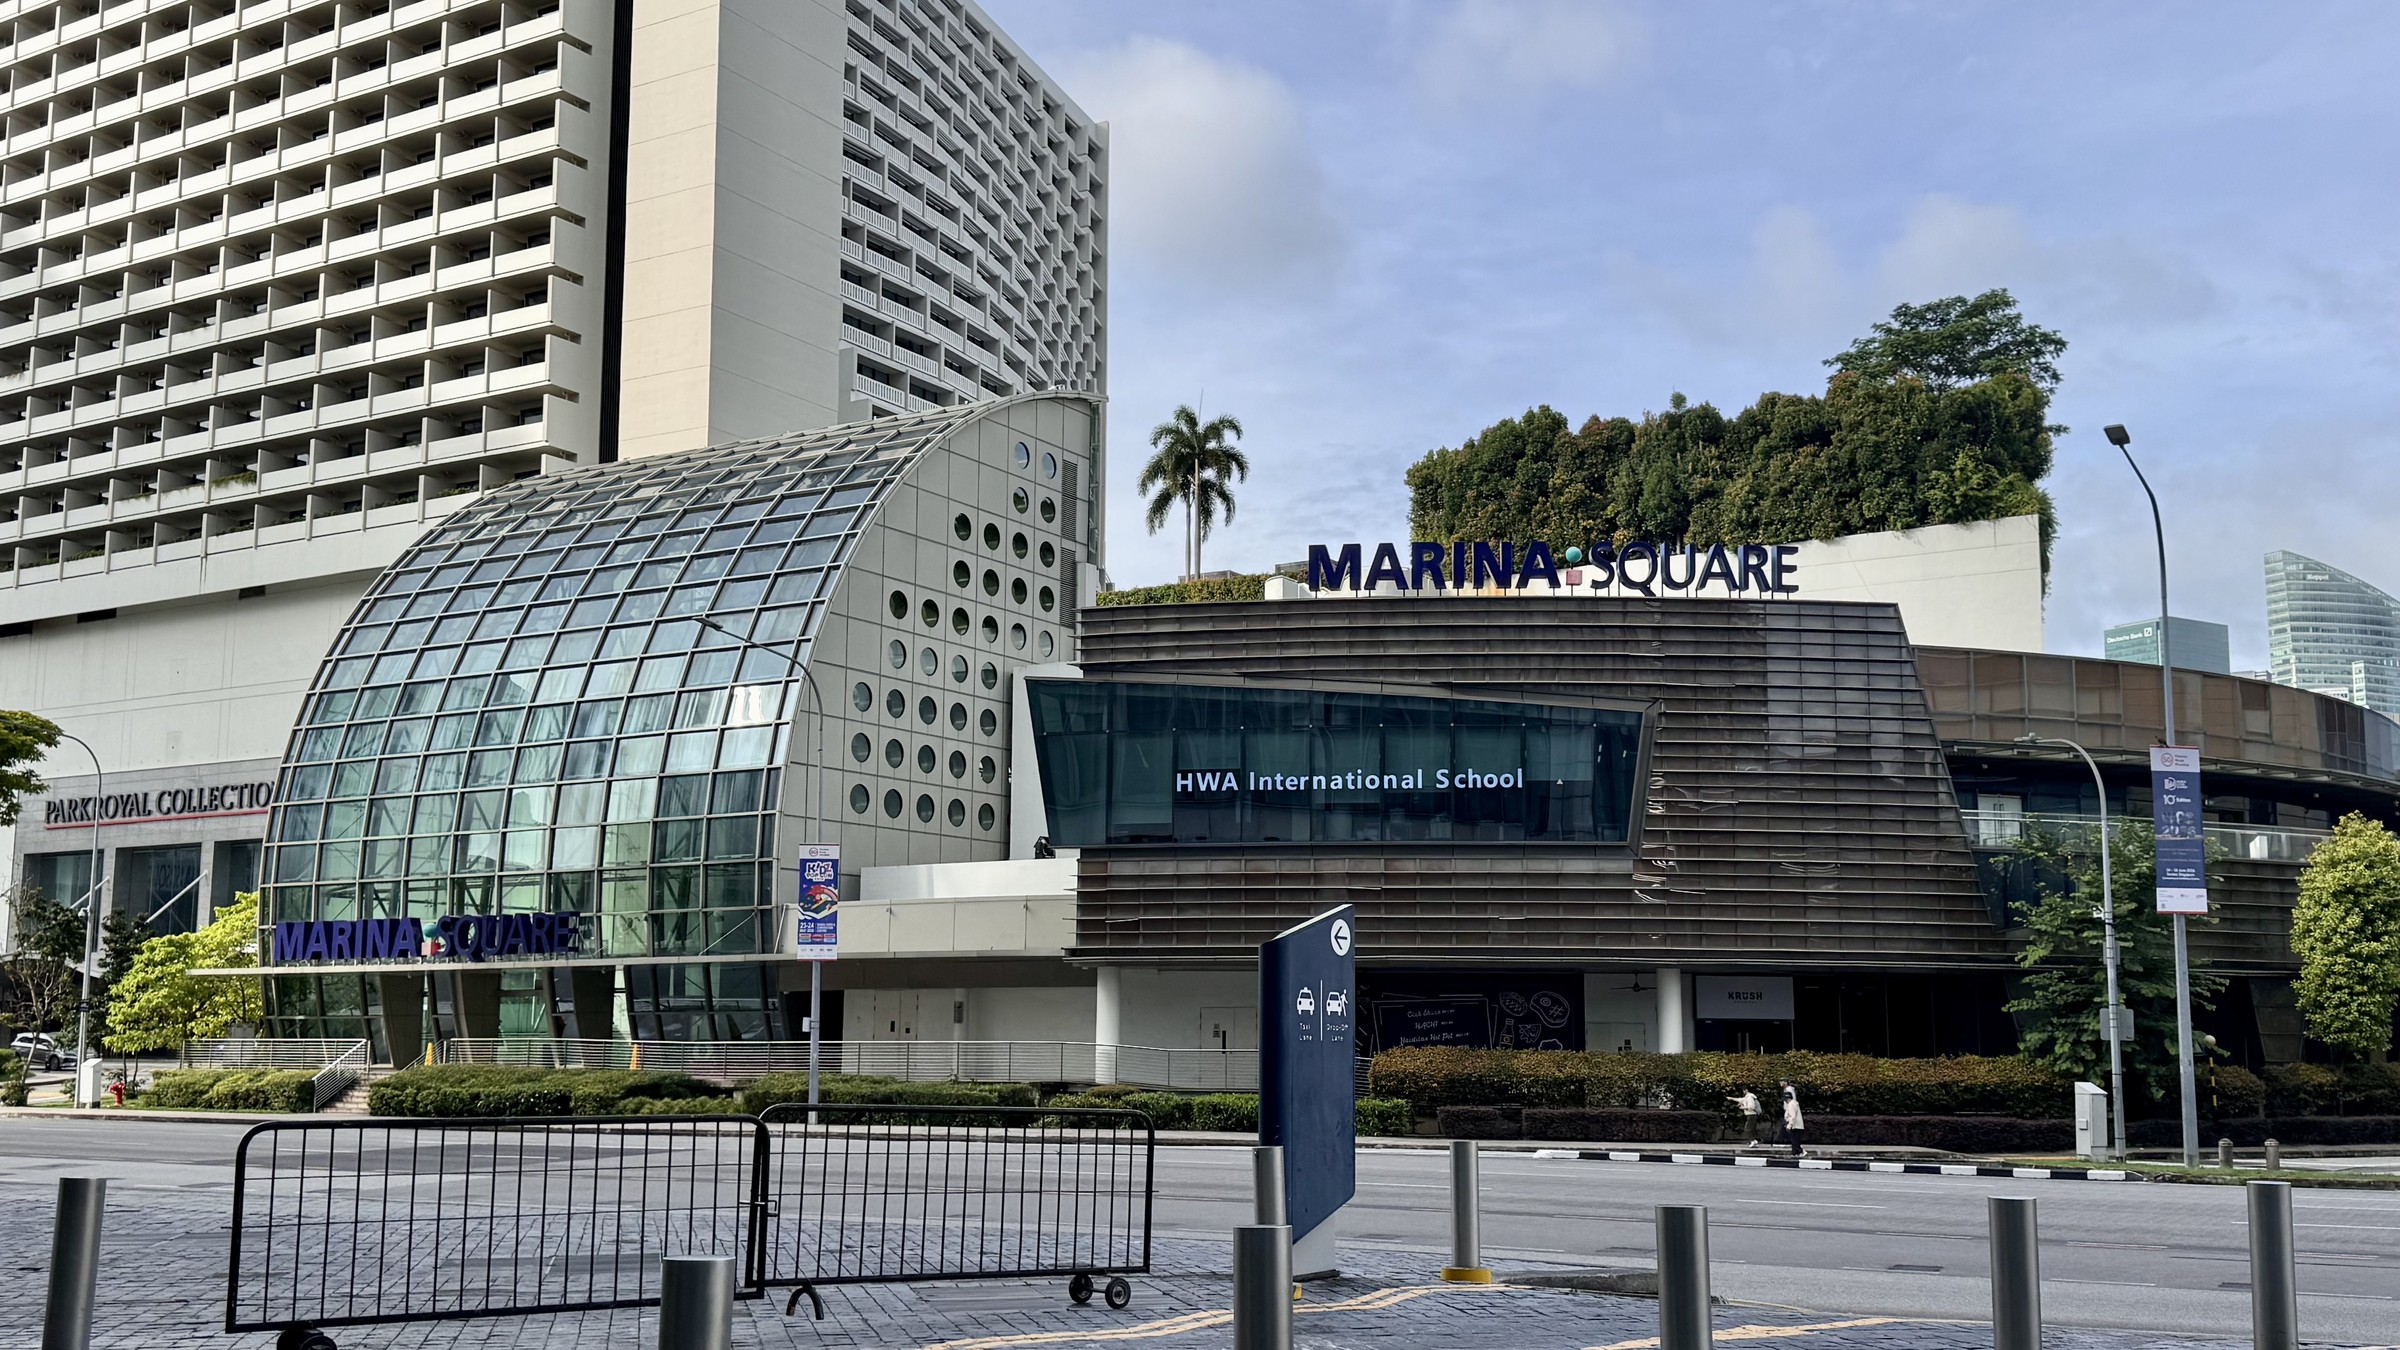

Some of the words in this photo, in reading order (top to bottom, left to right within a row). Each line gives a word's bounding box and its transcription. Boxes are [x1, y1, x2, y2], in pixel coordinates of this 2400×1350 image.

[1308, 541, 1561, 592] MARINA
[1589, 540, 1799, 597] SQUARE
[1175, 771, 1240, 792] HWA
[1249, 768, 1424, 791] International
[1435, 767, 1524, 789] School
[44, 791, 152, 825] PARKROYAL
[155, 781, 275, 816] COLLECTIO
[275, 917, 424, 961] MARINA
[436, 911, 578, 962] SQUARE
[1299, 1022, 1311, 1030] Taxi
[1326, 1023, 1349, 1031] Drop-Off
